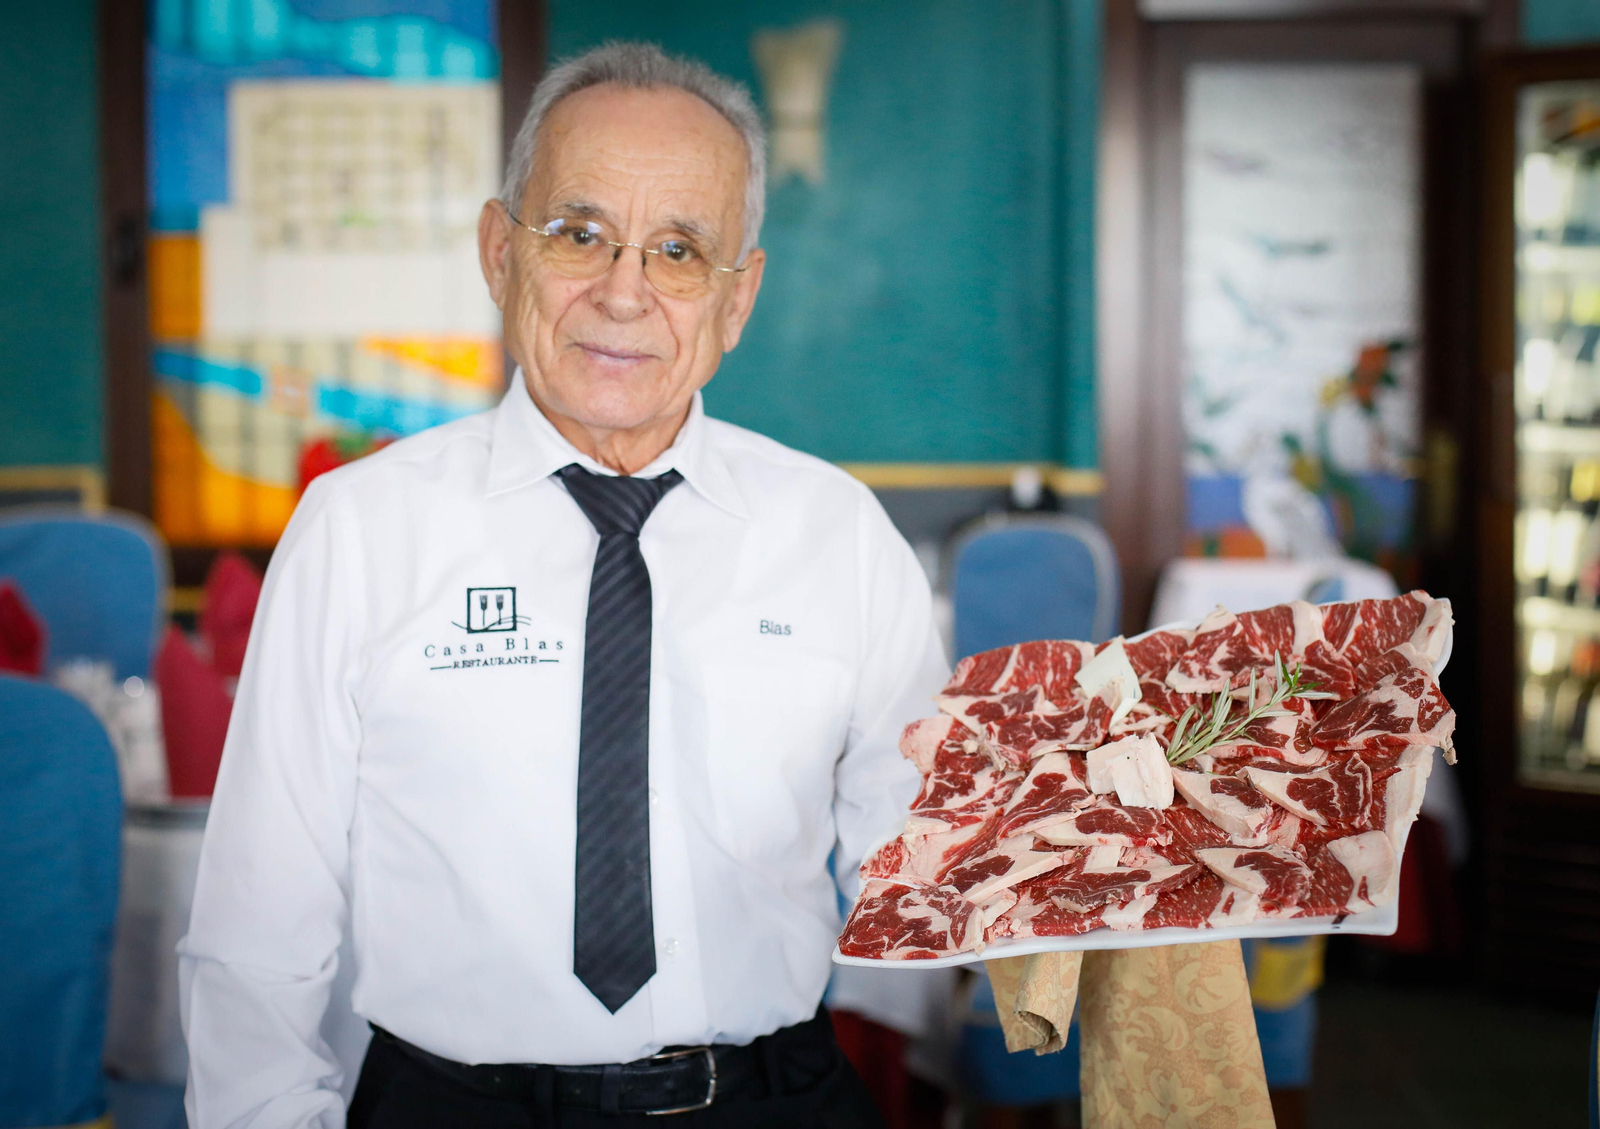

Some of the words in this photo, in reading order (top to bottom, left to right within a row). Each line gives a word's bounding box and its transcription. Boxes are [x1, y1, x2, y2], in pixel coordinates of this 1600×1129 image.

[760, 619, 792, 636] Blas
[424, 642, 484, 658] Casa
[505, 637, 564, 651] Blas
[453, 656, 538, 669] RESTAURANTE
